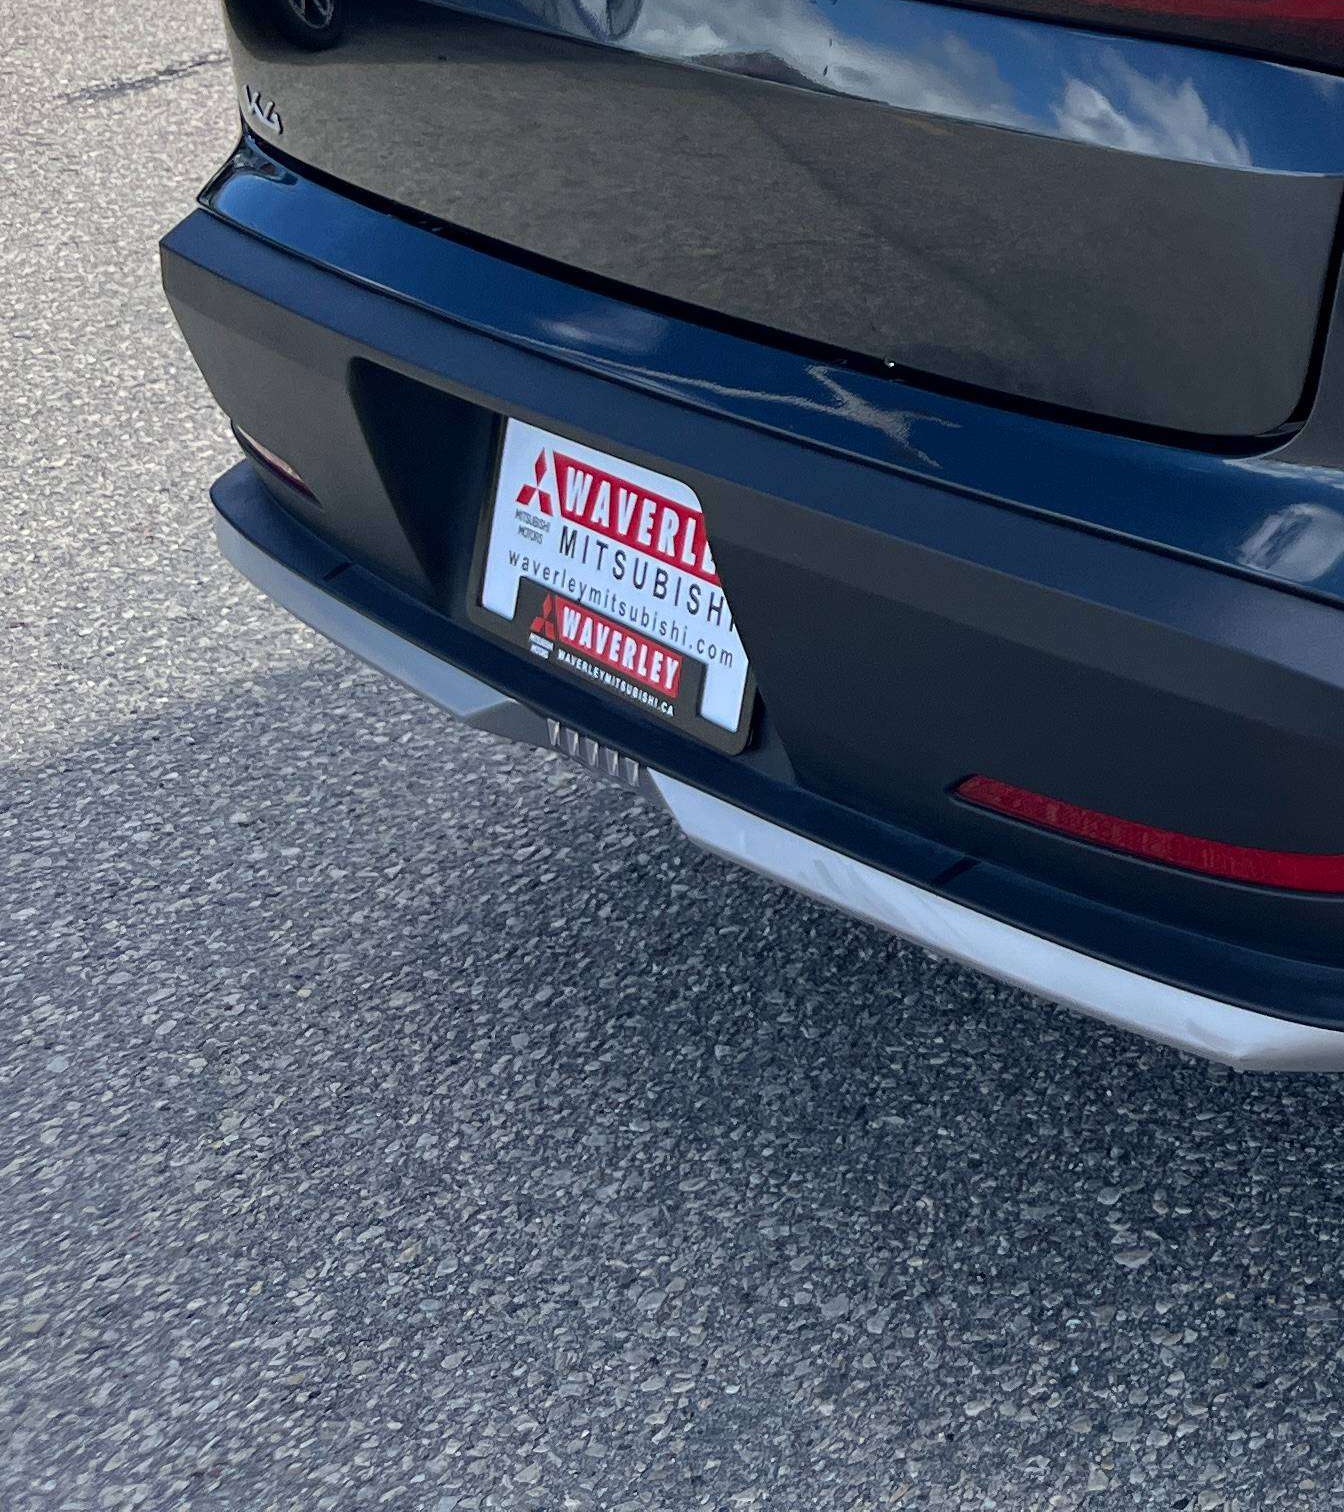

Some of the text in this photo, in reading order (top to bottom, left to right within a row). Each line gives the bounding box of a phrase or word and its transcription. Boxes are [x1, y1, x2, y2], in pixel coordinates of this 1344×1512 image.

[508, 549, 734, 669] waverleymitsubishi.com
[562, 605, 680, 690] WAVERLEY
[557, 648, 674, 718] WAVERLEYMITSUBISHI.CA
